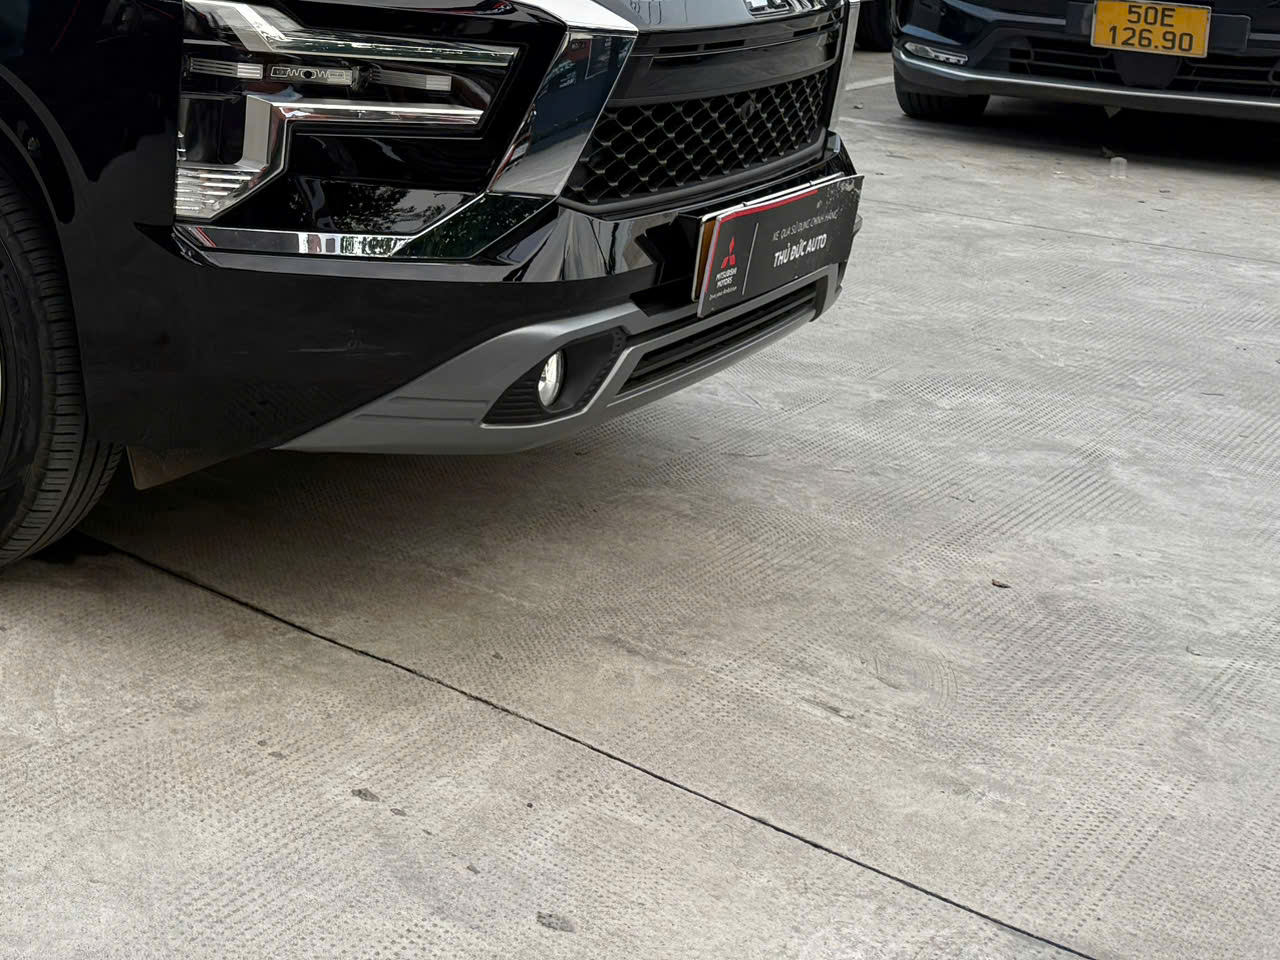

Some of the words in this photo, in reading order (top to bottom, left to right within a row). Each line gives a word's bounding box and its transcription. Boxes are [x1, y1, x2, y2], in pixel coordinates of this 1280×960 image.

[1128, 4, 1176, 27] 50E
[1108, 25, 1194, 52] 126.90
[773, 242, 790, 268] THỦ
[790, 239, 806, 261] ĐỨC
[806, 234, 827, 254] AUTO
